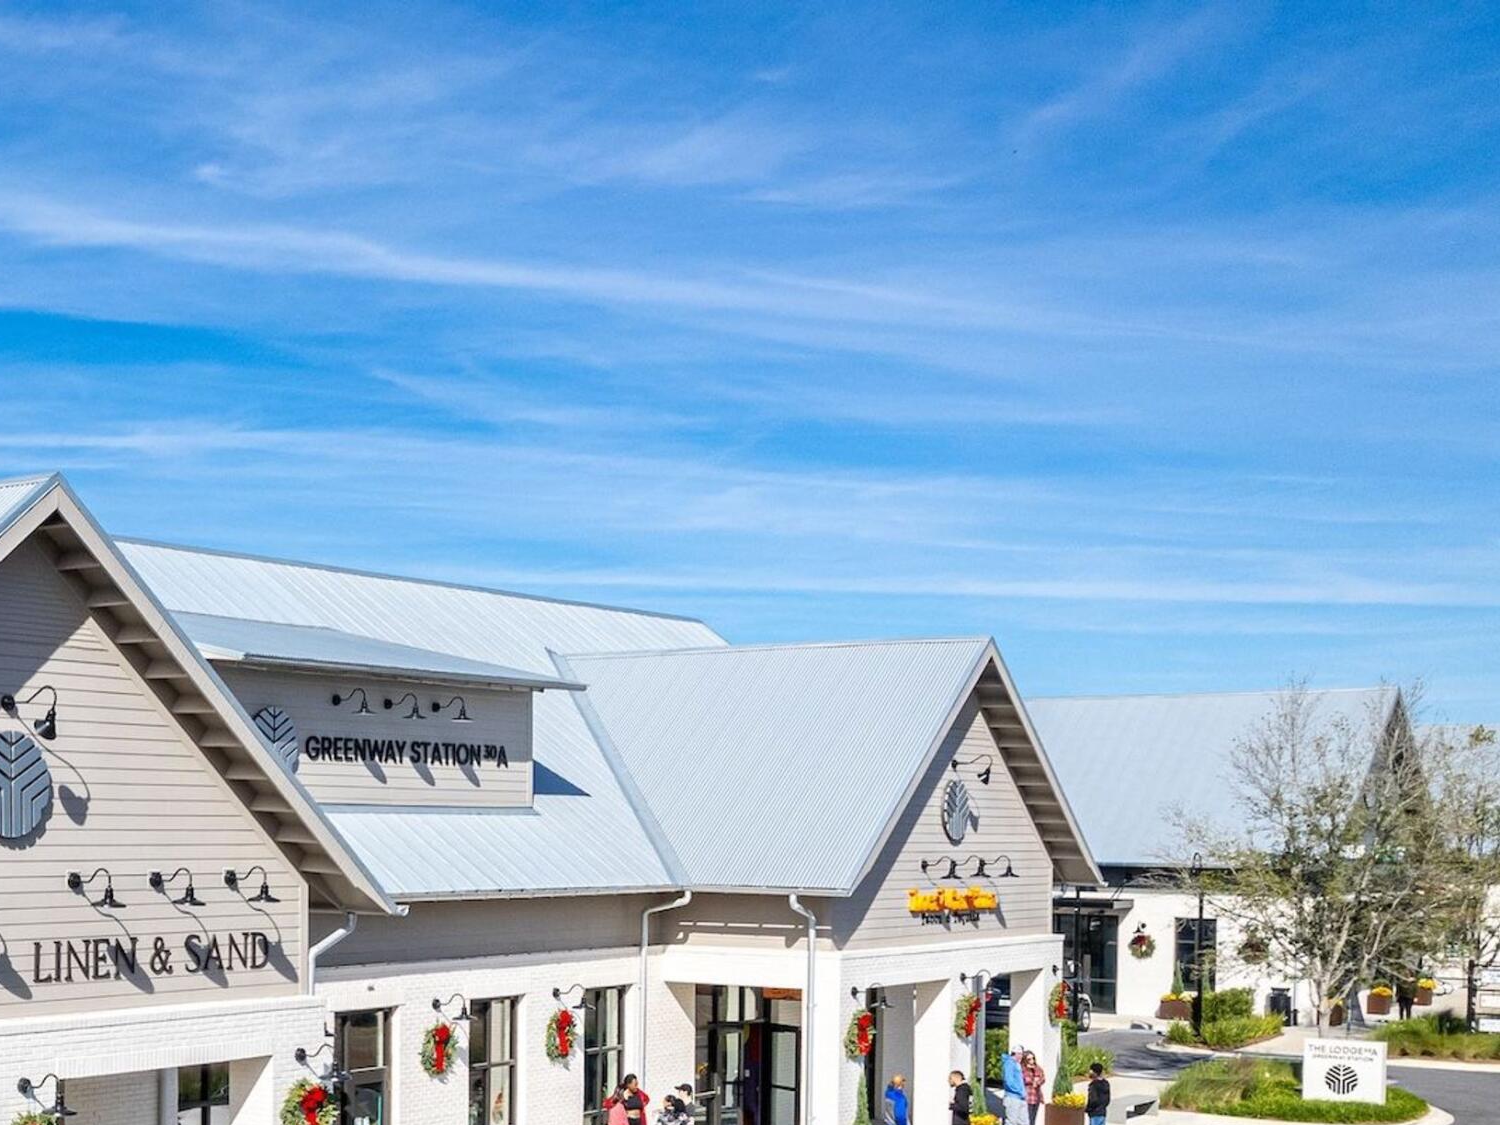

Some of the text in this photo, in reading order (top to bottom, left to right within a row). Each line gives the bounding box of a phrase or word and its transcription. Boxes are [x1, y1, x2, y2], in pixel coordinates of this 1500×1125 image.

[305, 735, 509, 769] GREENWAY STATION 30A
[33, 931, 270, 983] LINEN & SAND
